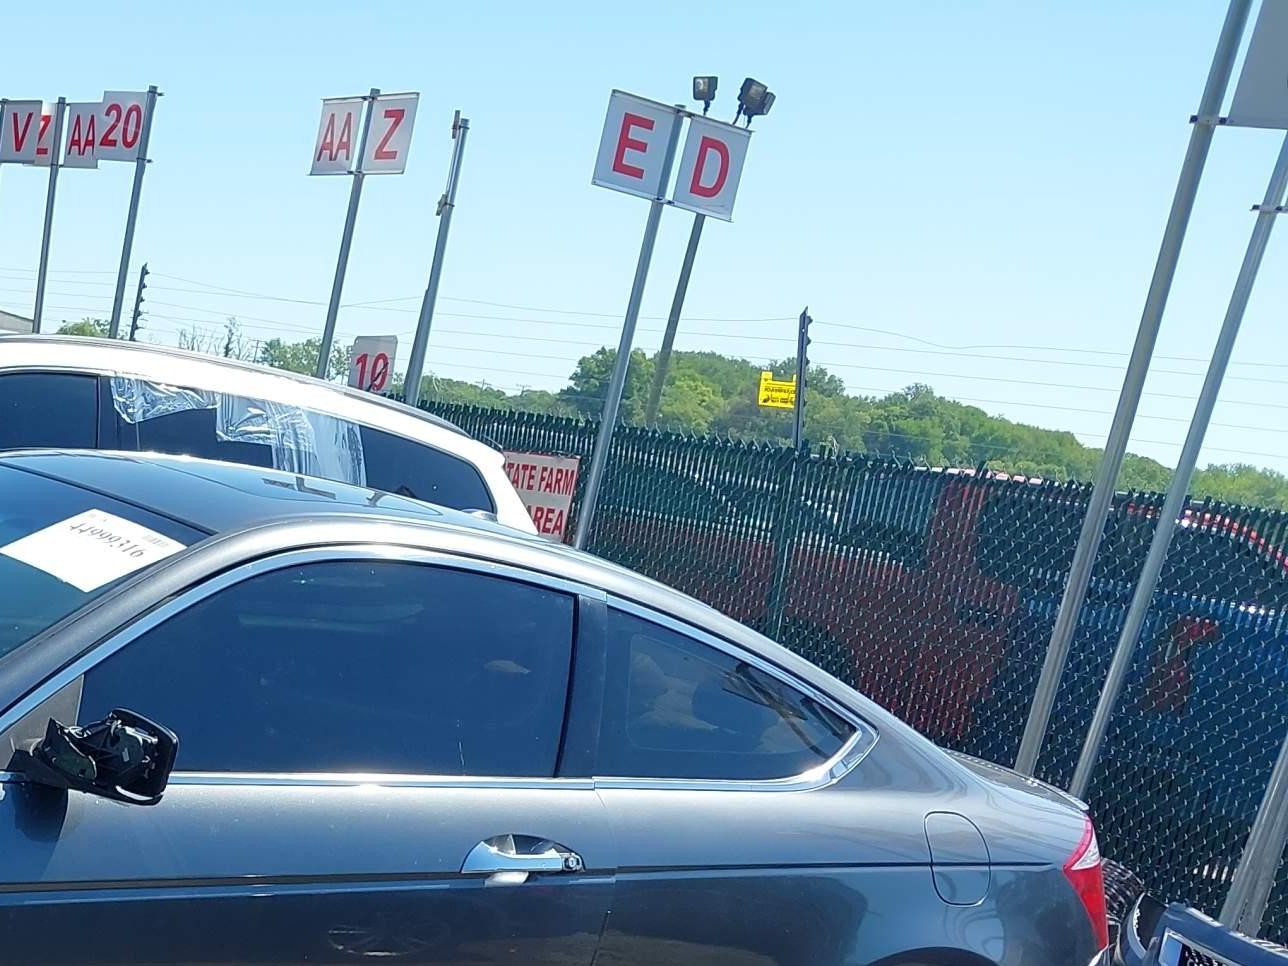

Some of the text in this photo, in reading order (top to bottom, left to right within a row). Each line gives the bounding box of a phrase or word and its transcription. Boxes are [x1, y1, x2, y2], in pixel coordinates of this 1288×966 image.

[12, 111, 34, 152] V
[67, 114, 96, 156] AA
[99, 103, 142, 149] 20
[316, 112, 353, 162] AA
[373, 108, 406, 160] Z
[612, 111, 655, 180] E
[689, 135, 730, 199] D
[355, 352, 389, 391] 10
[506, 463, 575, 496] TATE FARM
